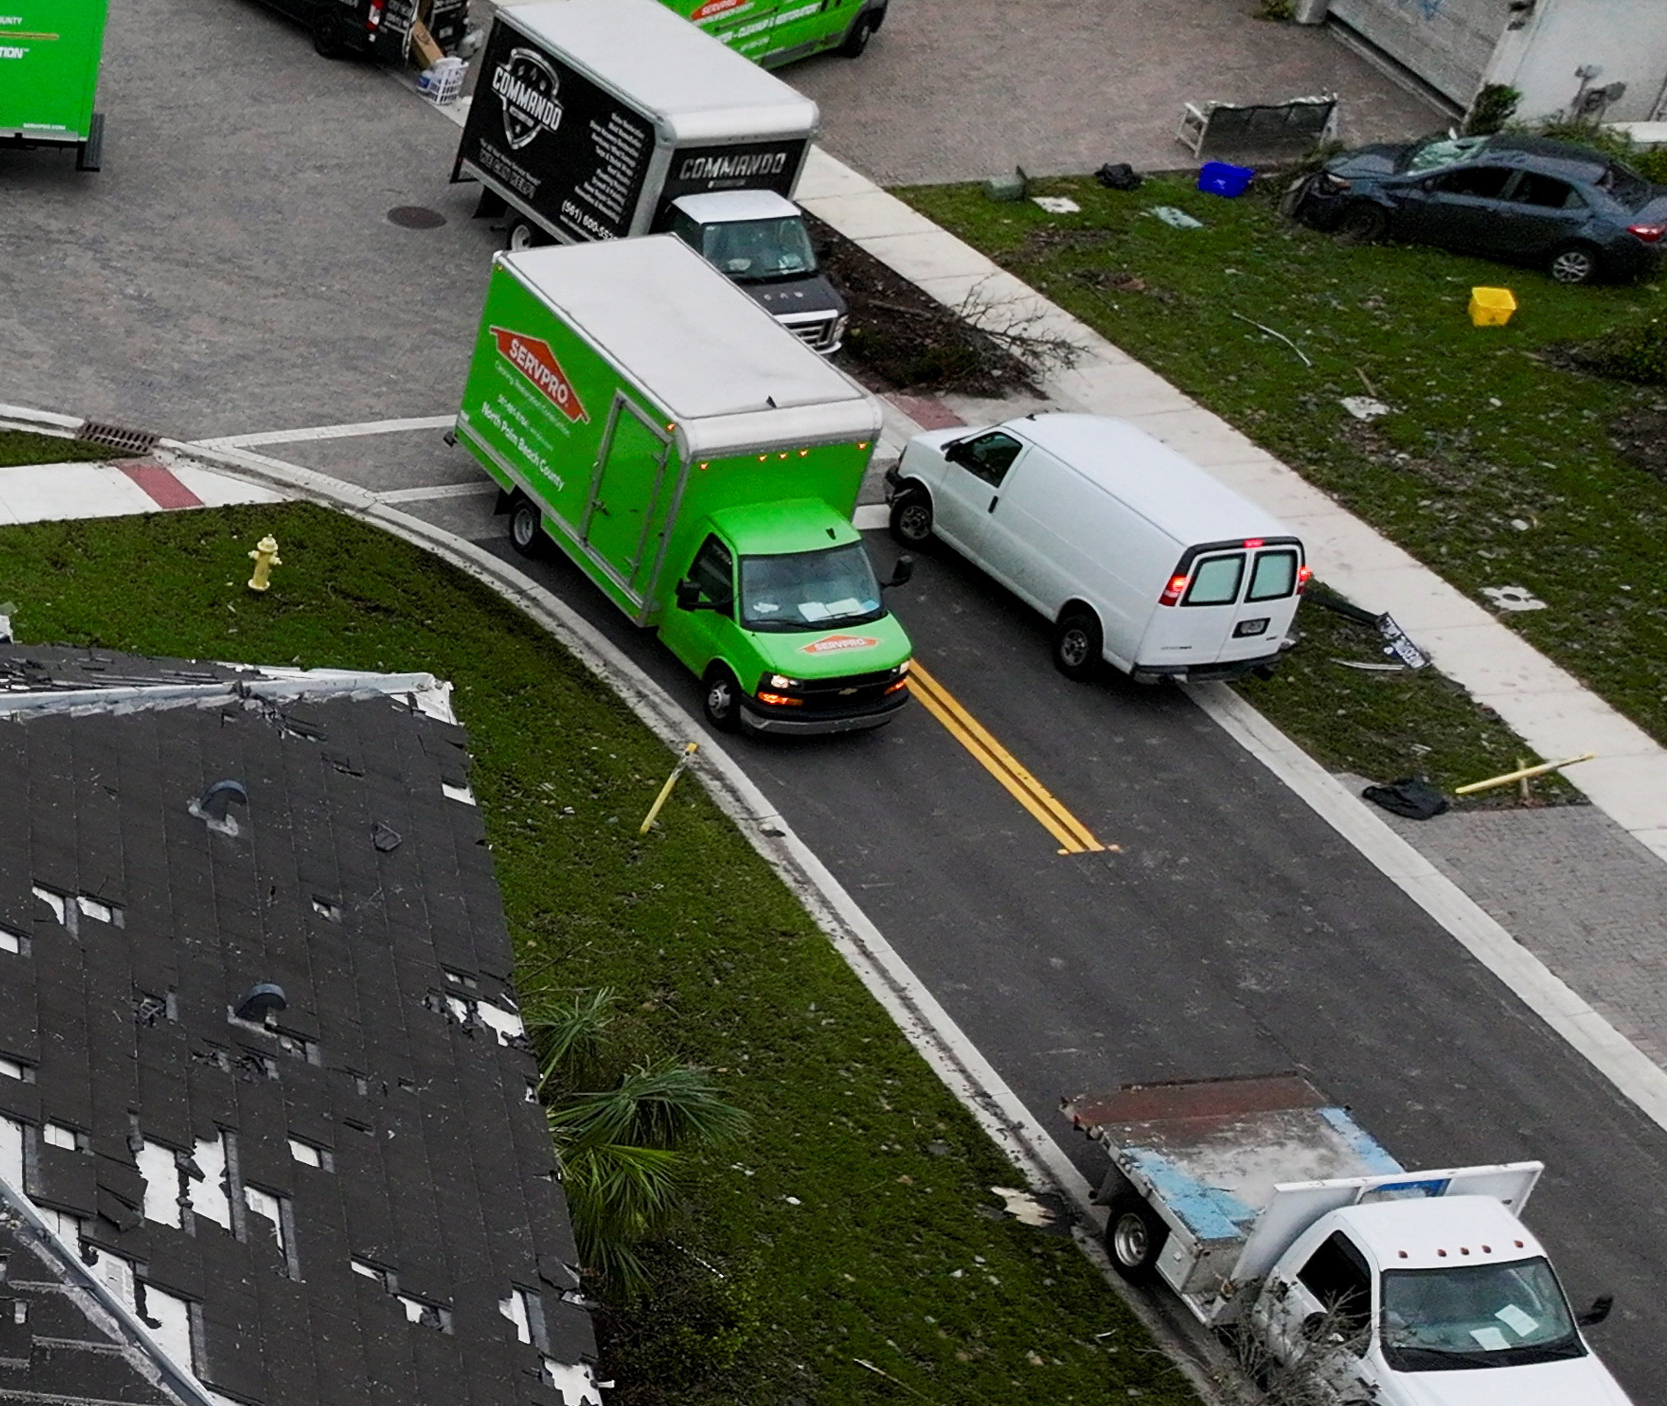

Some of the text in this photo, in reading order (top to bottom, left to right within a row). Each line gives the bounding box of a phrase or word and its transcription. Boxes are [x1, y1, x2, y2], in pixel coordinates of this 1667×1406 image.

[492, 66, 562, 131] COMMANDO
[679, 153, 787, 180] COMMANDO
[561, 199, 583, 224] (561)
[509, 338, 568, 404] SERVPRO
[481, 401, 501, 429] North
[500, 423, 518, 447] Palm
[518, 437, 539, 468] Beach
[539, 459, 565, 492] County
[814, 638, 865, 651] SERVPRO
